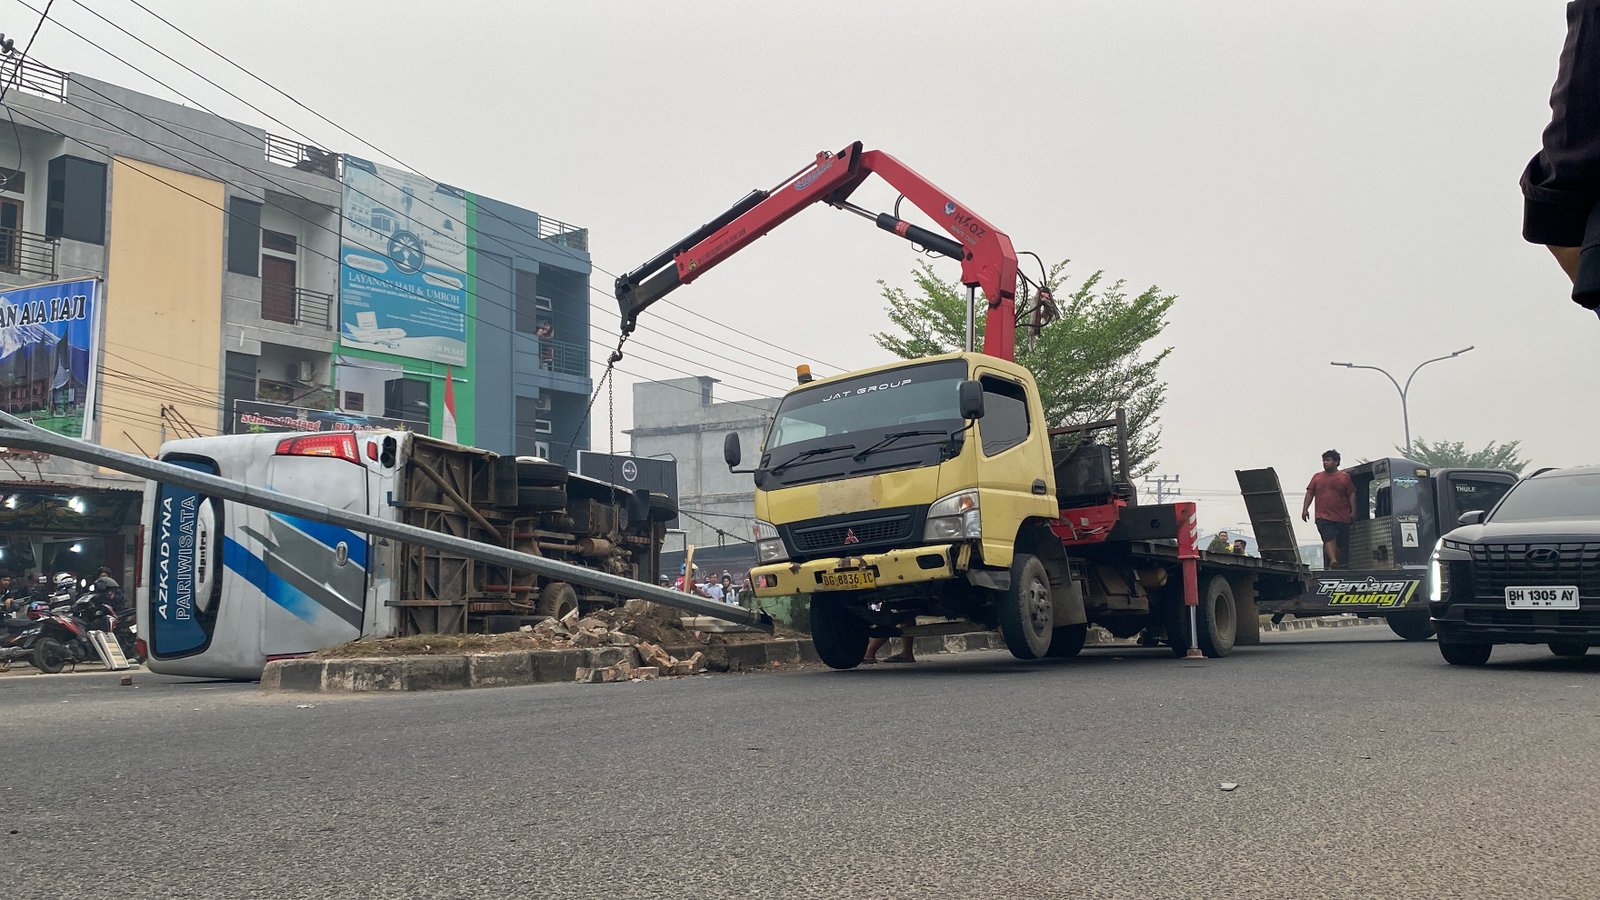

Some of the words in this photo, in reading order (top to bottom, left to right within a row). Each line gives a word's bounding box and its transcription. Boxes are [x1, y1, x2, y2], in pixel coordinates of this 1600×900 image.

[349, 272, 392, 289] LAYANAN
[416, 288, 424, 296] &
[426, 289, 460, 304] UMROH
[50, 296, 86, 322] HAJI
[822, 390, 852, 402] JAT
[856, 379, 912, 395] GROUP
[1406, 533, 1415, 543] A
[158, 497, 173, 620] AZKADYNA
[176, 495, 195, 620] PARIWISATA
[823, 576, 835, 586] BG
[837, 573, 860, 585] 8836
[863, 572, 874, 583] IC
[1319, 578, 1405, 593] Perdana
[1331, 592, 1398, 606] Towing
[1508, 590, 1524, 600] BH
[1528, 590, 1557, 600] 1305
[1561, 590, 1574, 600] AY
